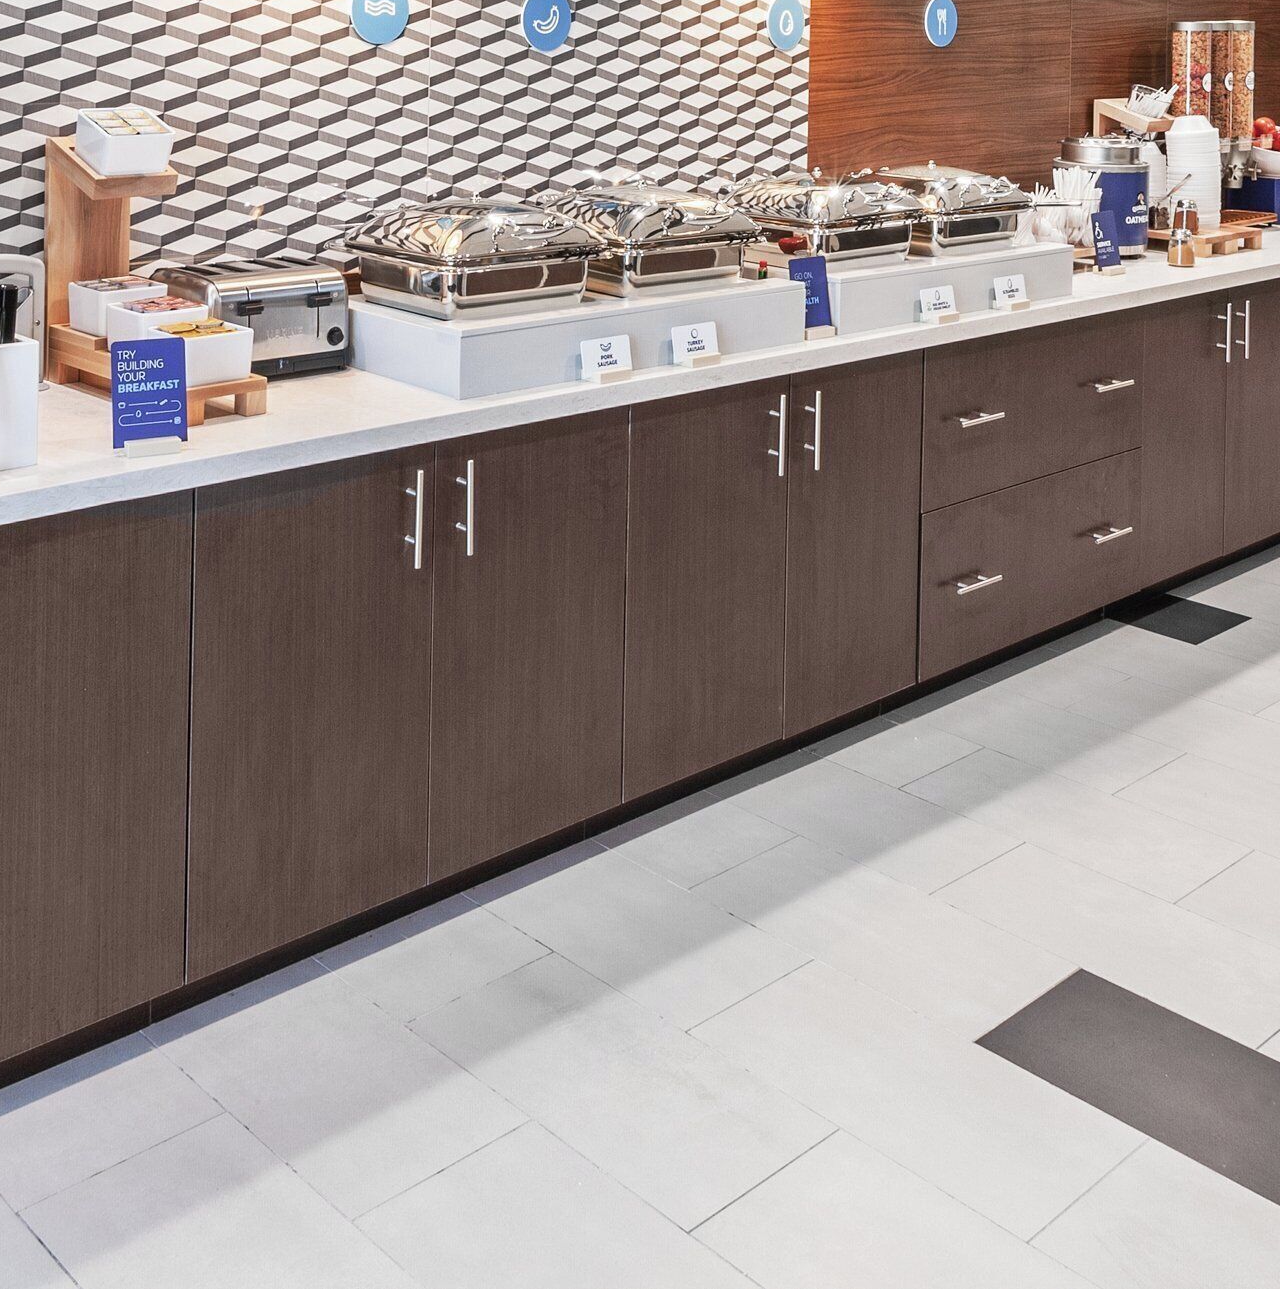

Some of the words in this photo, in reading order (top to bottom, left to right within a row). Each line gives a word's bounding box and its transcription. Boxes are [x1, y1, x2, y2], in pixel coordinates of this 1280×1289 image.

[794, 272, 803, 280] GO
[687, 339, 704, 347] TURKEY
[686, 345, 706, 353] SAUSAGE
[117, 350, 136, 360] TRY
[117, 358, 164, 372] BUILDING
[597, 359, 618, 368] SAUSAGE
[117, 371, 146, 382] YOUR
[118, 379, 180, 394] BREAKFAST
